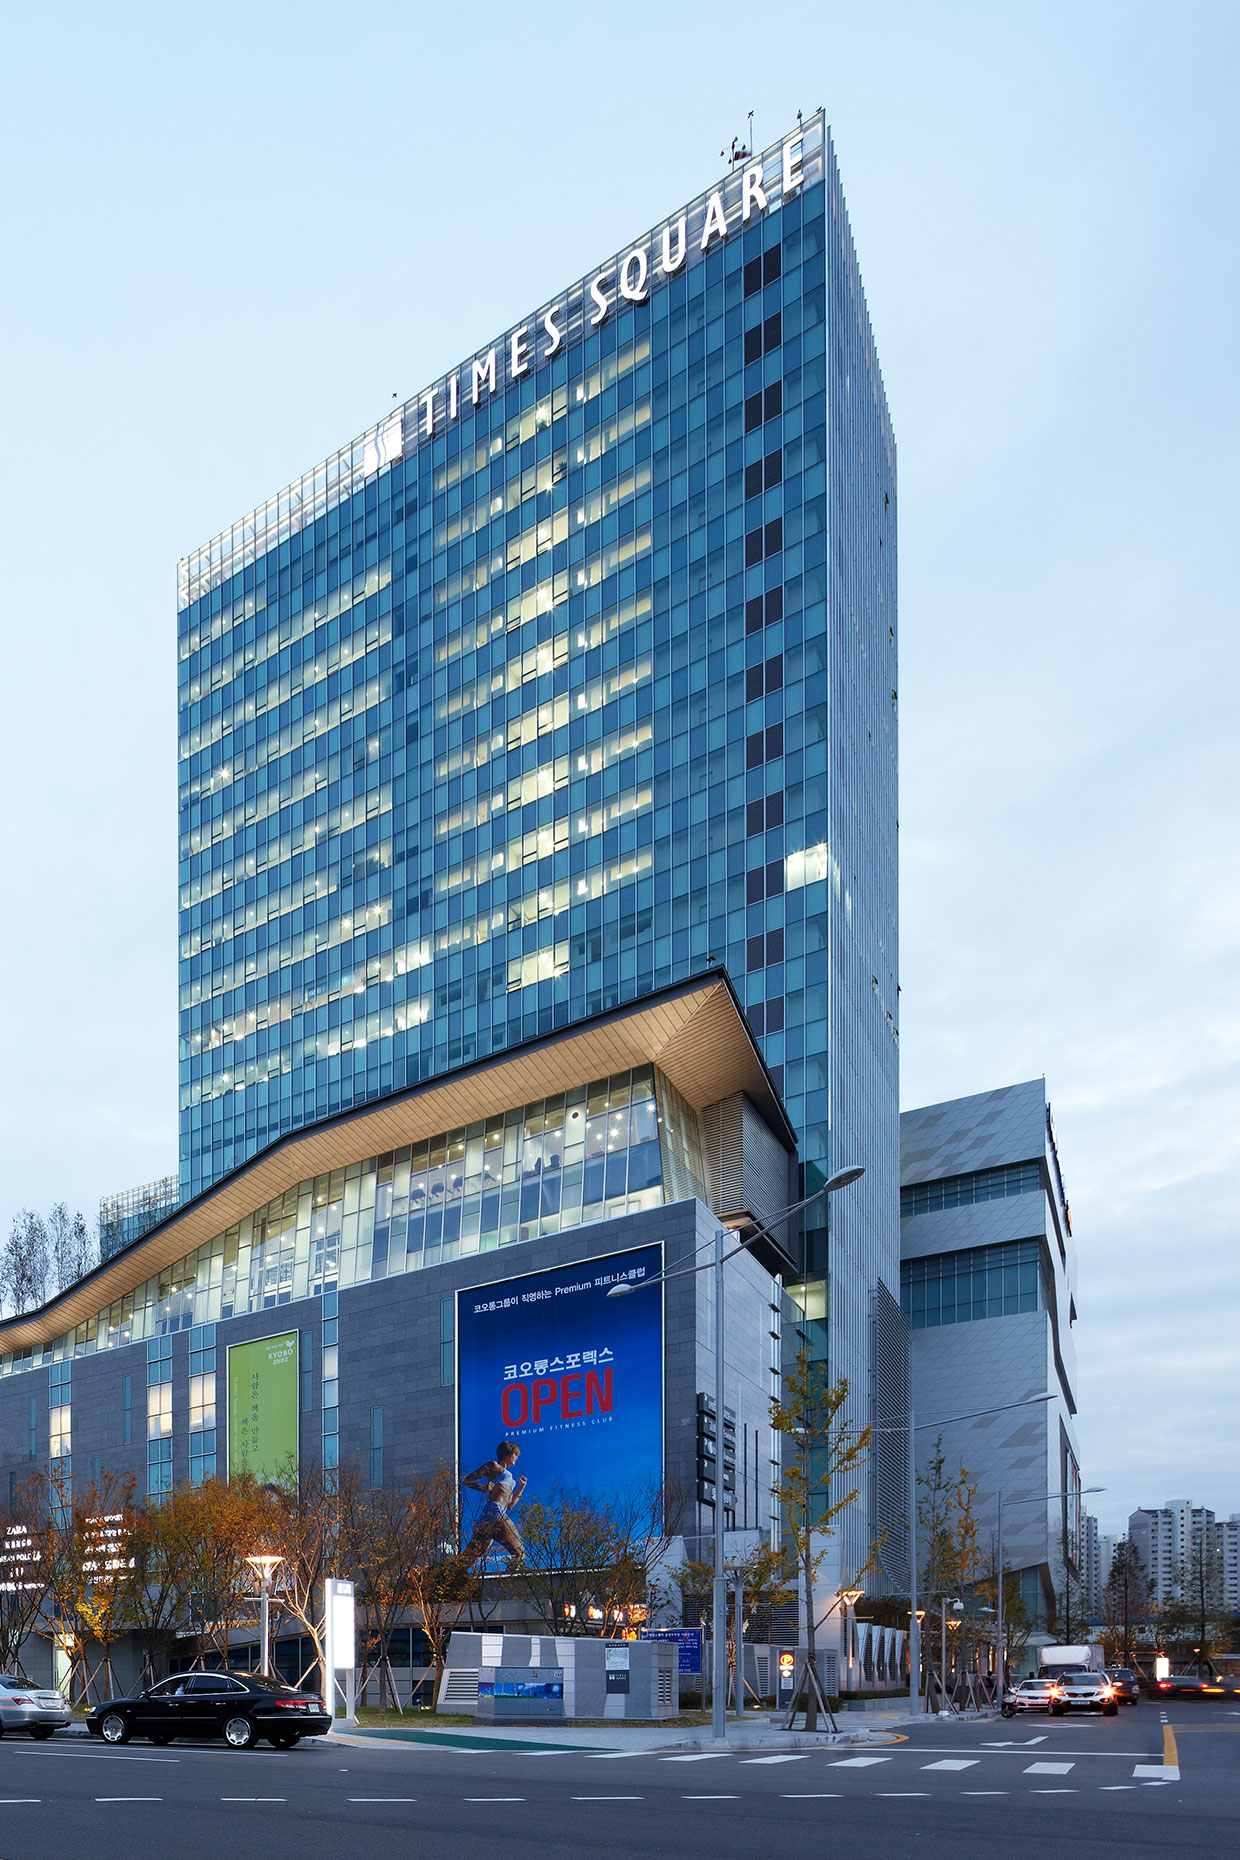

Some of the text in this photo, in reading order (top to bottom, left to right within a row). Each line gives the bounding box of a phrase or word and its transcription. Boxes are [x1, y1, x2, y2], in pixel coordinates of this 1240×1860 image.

[420, 131, 805, 436] TIMES SQUARE
[473, 1266, 646, 1313] 코오롱그룹이 직영하는 Premium 피트니스클럽
[268, 1348, 294, 1361] KYOBO
[503, 1347, 614, 1381] 코오롱스포렉스
[501, 1367, 613, 1428] OPEN
[505, 1416, 613, 1437] PREMIUM FITNESS CLUB
[6, 1525, 27, 1535] ZARA
